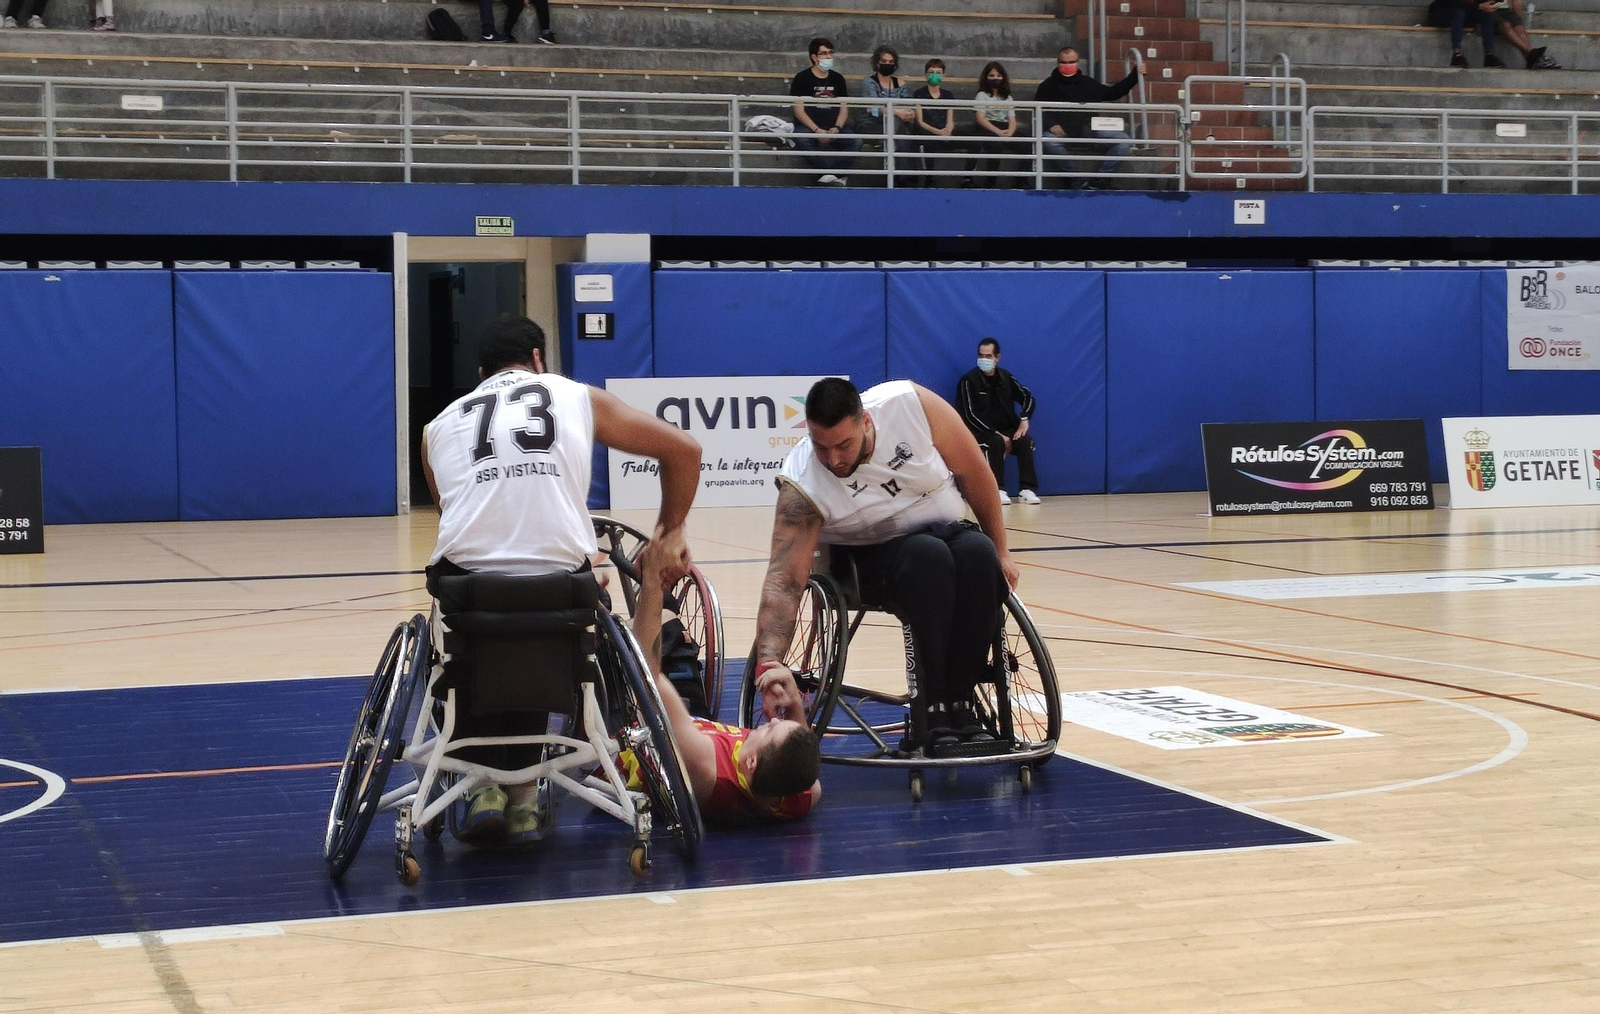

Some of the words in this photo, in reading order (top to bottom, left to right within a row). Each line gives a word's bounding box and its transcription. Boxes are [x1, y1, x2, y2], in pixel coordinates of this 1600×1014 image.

[477, 218, 500, 227] SALIDA
[502, 218, 512, 227] DE
[1520, 269, 1548, 302] BSR
[1575, 285, 1600, 294] BALO
[1549, 347, 1582, 357] ONCE
[656, 395, 777, 430] avin
[458, 381, 558, 467] 73
[1503, 448, 1566, 459] AYUNTAMIENTO
[1568, 448, 1579, 457] DE
[621, 459, 660, 478] Trabaj
[700, 462, 713, 471] or
[717, 457, 728, 471] la
[732, 457, 784, 475] integraci
[1380, 460, 1404, 468] VISUAL
[475, 467, 500, 484] BSR
[502, 462, 561, 478] VISTAZUL
[1503, 459, 1582, 482] GETAFE
[705, 478, 765, 488] grupoavin.org
[1369, 483, 1388, 493] 669
[1389, 482, 1408, 493] 783
[1409, 481, 1427, 492] 791
[1216, 499, 1353, 513] rotulossystem@rotulossystem.com
[1370, 496, 1389, 507] 916
[1390, 495, 1409, 506] 092
[1410, 495, 1429, 505] 858
[0, 519, 13, 528] 28
[15, 518, 30, 528] 58
[8, 530, 28, 540] 791
[1098, 688, 1259, 723] GETAFE
